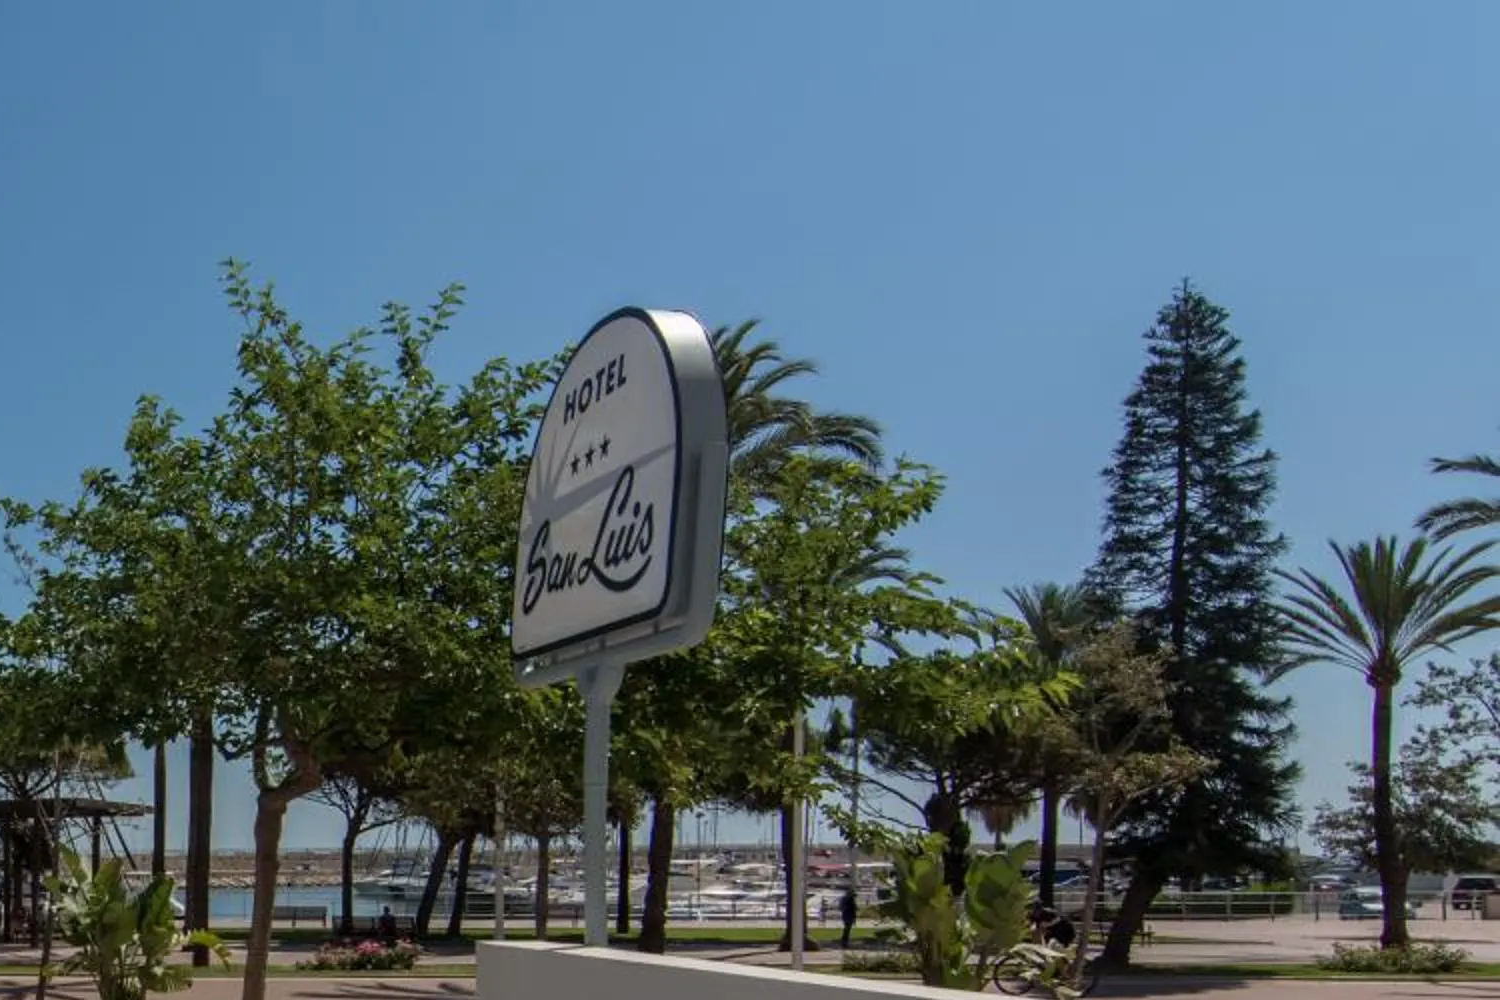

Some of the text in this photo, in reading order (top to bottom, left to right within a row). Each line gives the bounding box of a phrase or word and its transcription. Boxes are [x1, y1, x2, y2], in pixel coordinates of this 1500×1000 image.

[562, 353, 627, 425] HOTEL
[522, 464, 655, 616] San Luis
